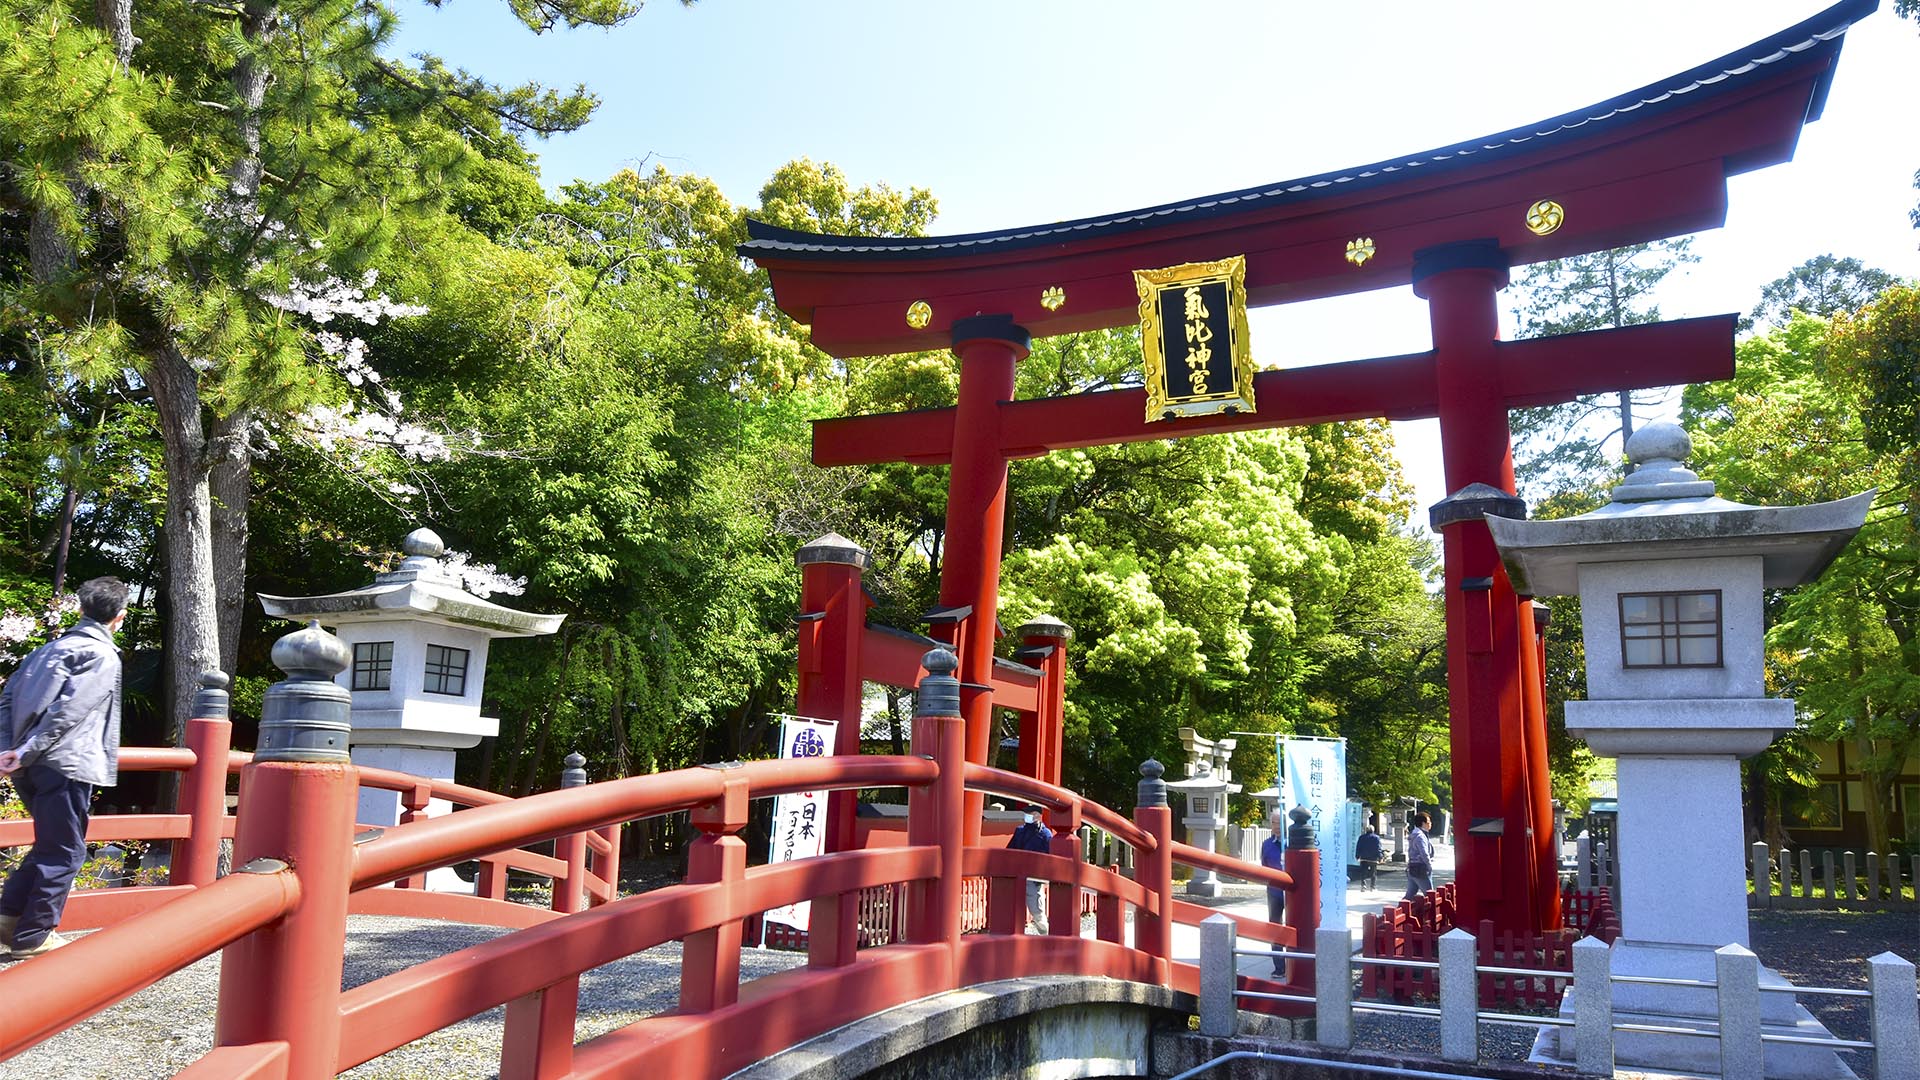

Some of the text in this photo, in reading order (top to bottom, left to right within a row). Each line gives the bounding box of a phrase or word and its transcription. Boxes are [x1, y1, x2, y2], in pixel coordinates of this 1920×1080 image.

[1184, 286, 1214, 395] 氣比神宮
[800, 729, 821, 744] 日本
[1310, 757, 1323, 799] 神棚に
[797, 801, 817, 841] 日本
